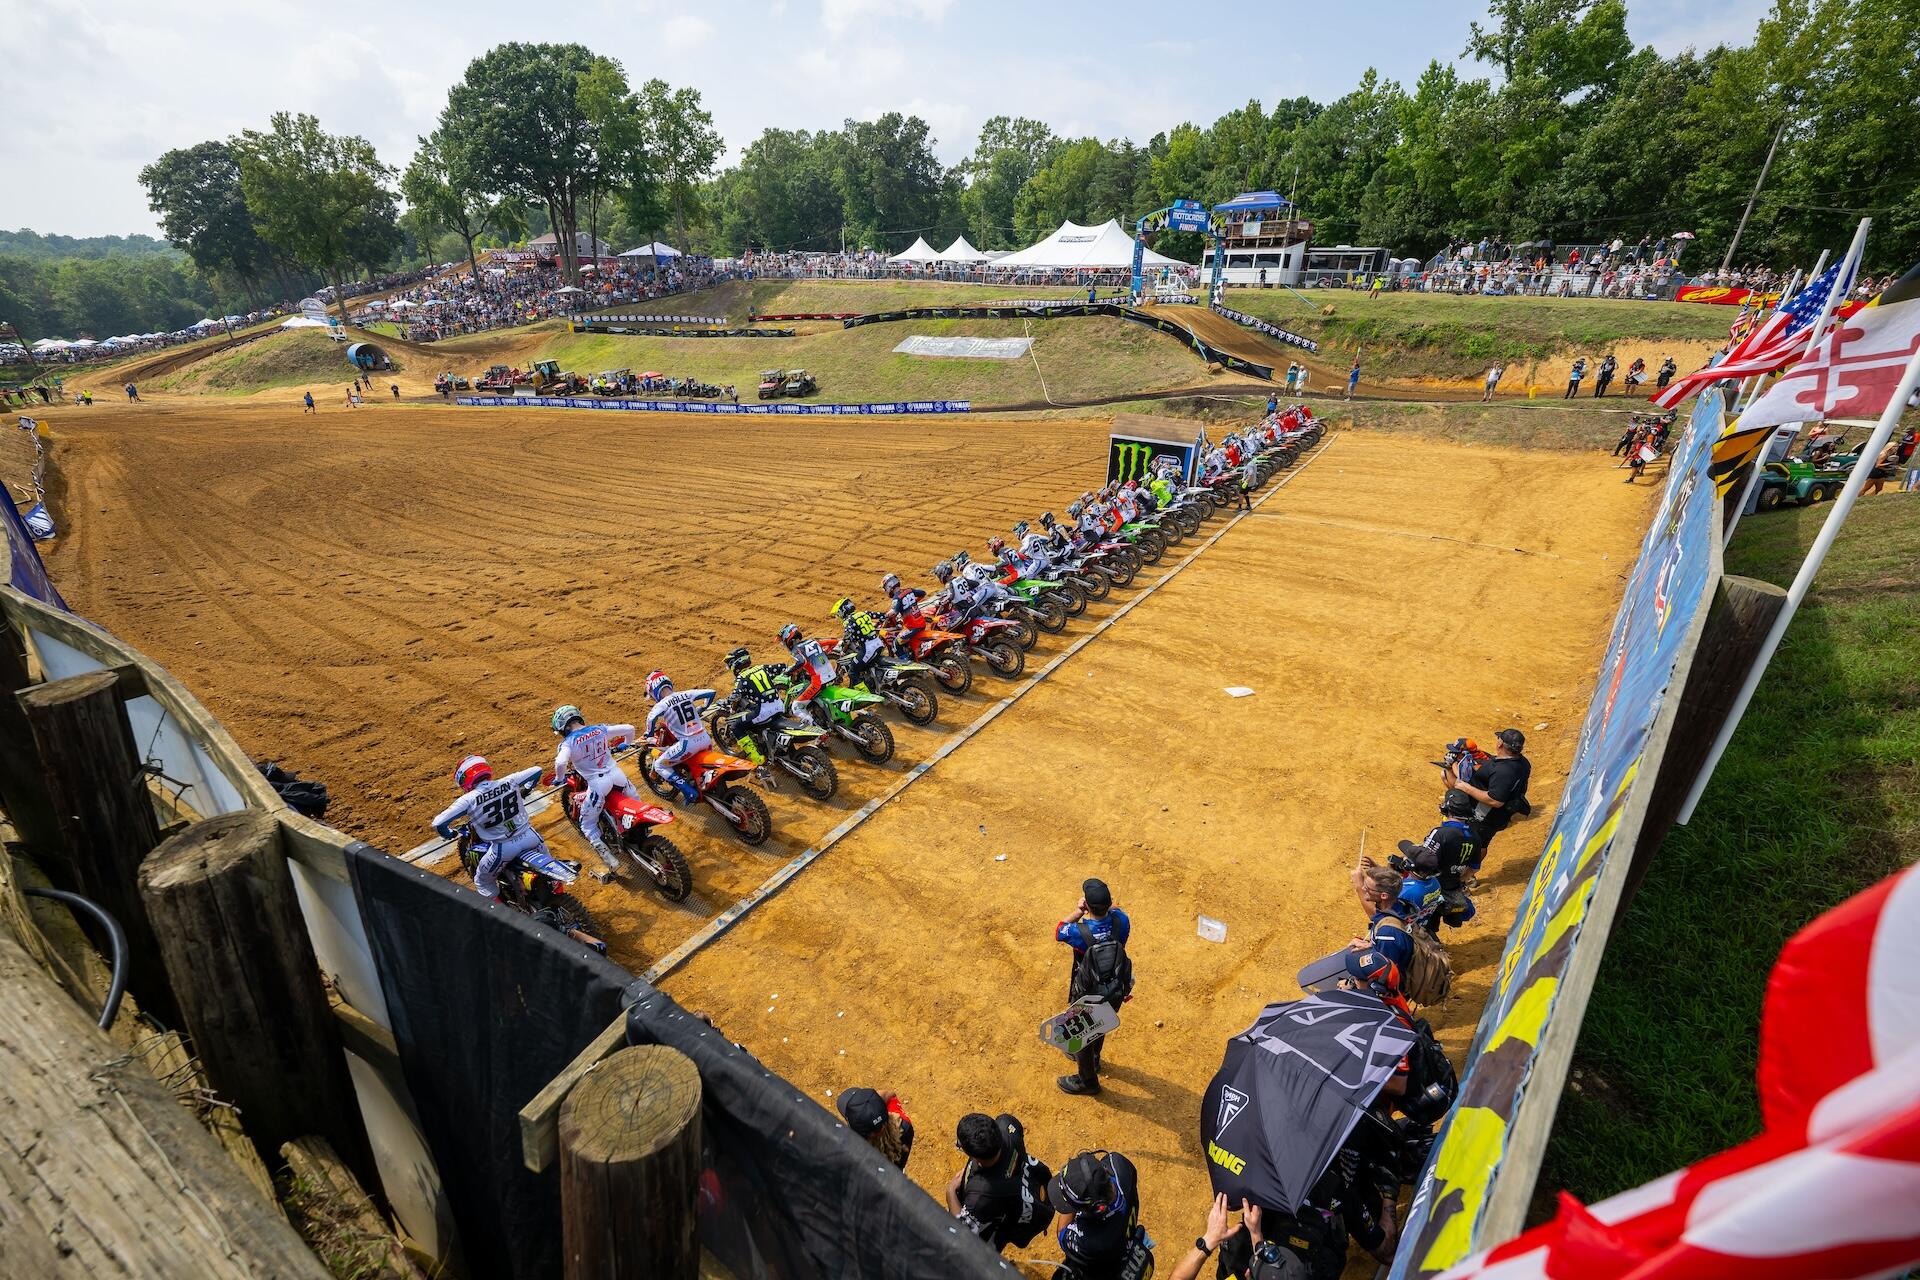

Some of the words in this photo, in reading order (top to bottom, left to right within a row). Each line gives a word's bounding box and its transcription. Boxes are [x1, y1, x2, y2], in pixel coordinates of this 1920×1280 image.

[1173, 211, 1206, 222] MOTOCROSS
[1179, 223, 1198, 231] FINISH
[749, 669, 772, 694] 17
[666, 693, 691, 708] VIALLE
[672, 700, 695, 726] 16
[576, 729, 601, 745] HYMAS
[475, 782, 511, 806] DEEGAN
[482, 790, 520, 829] 38
